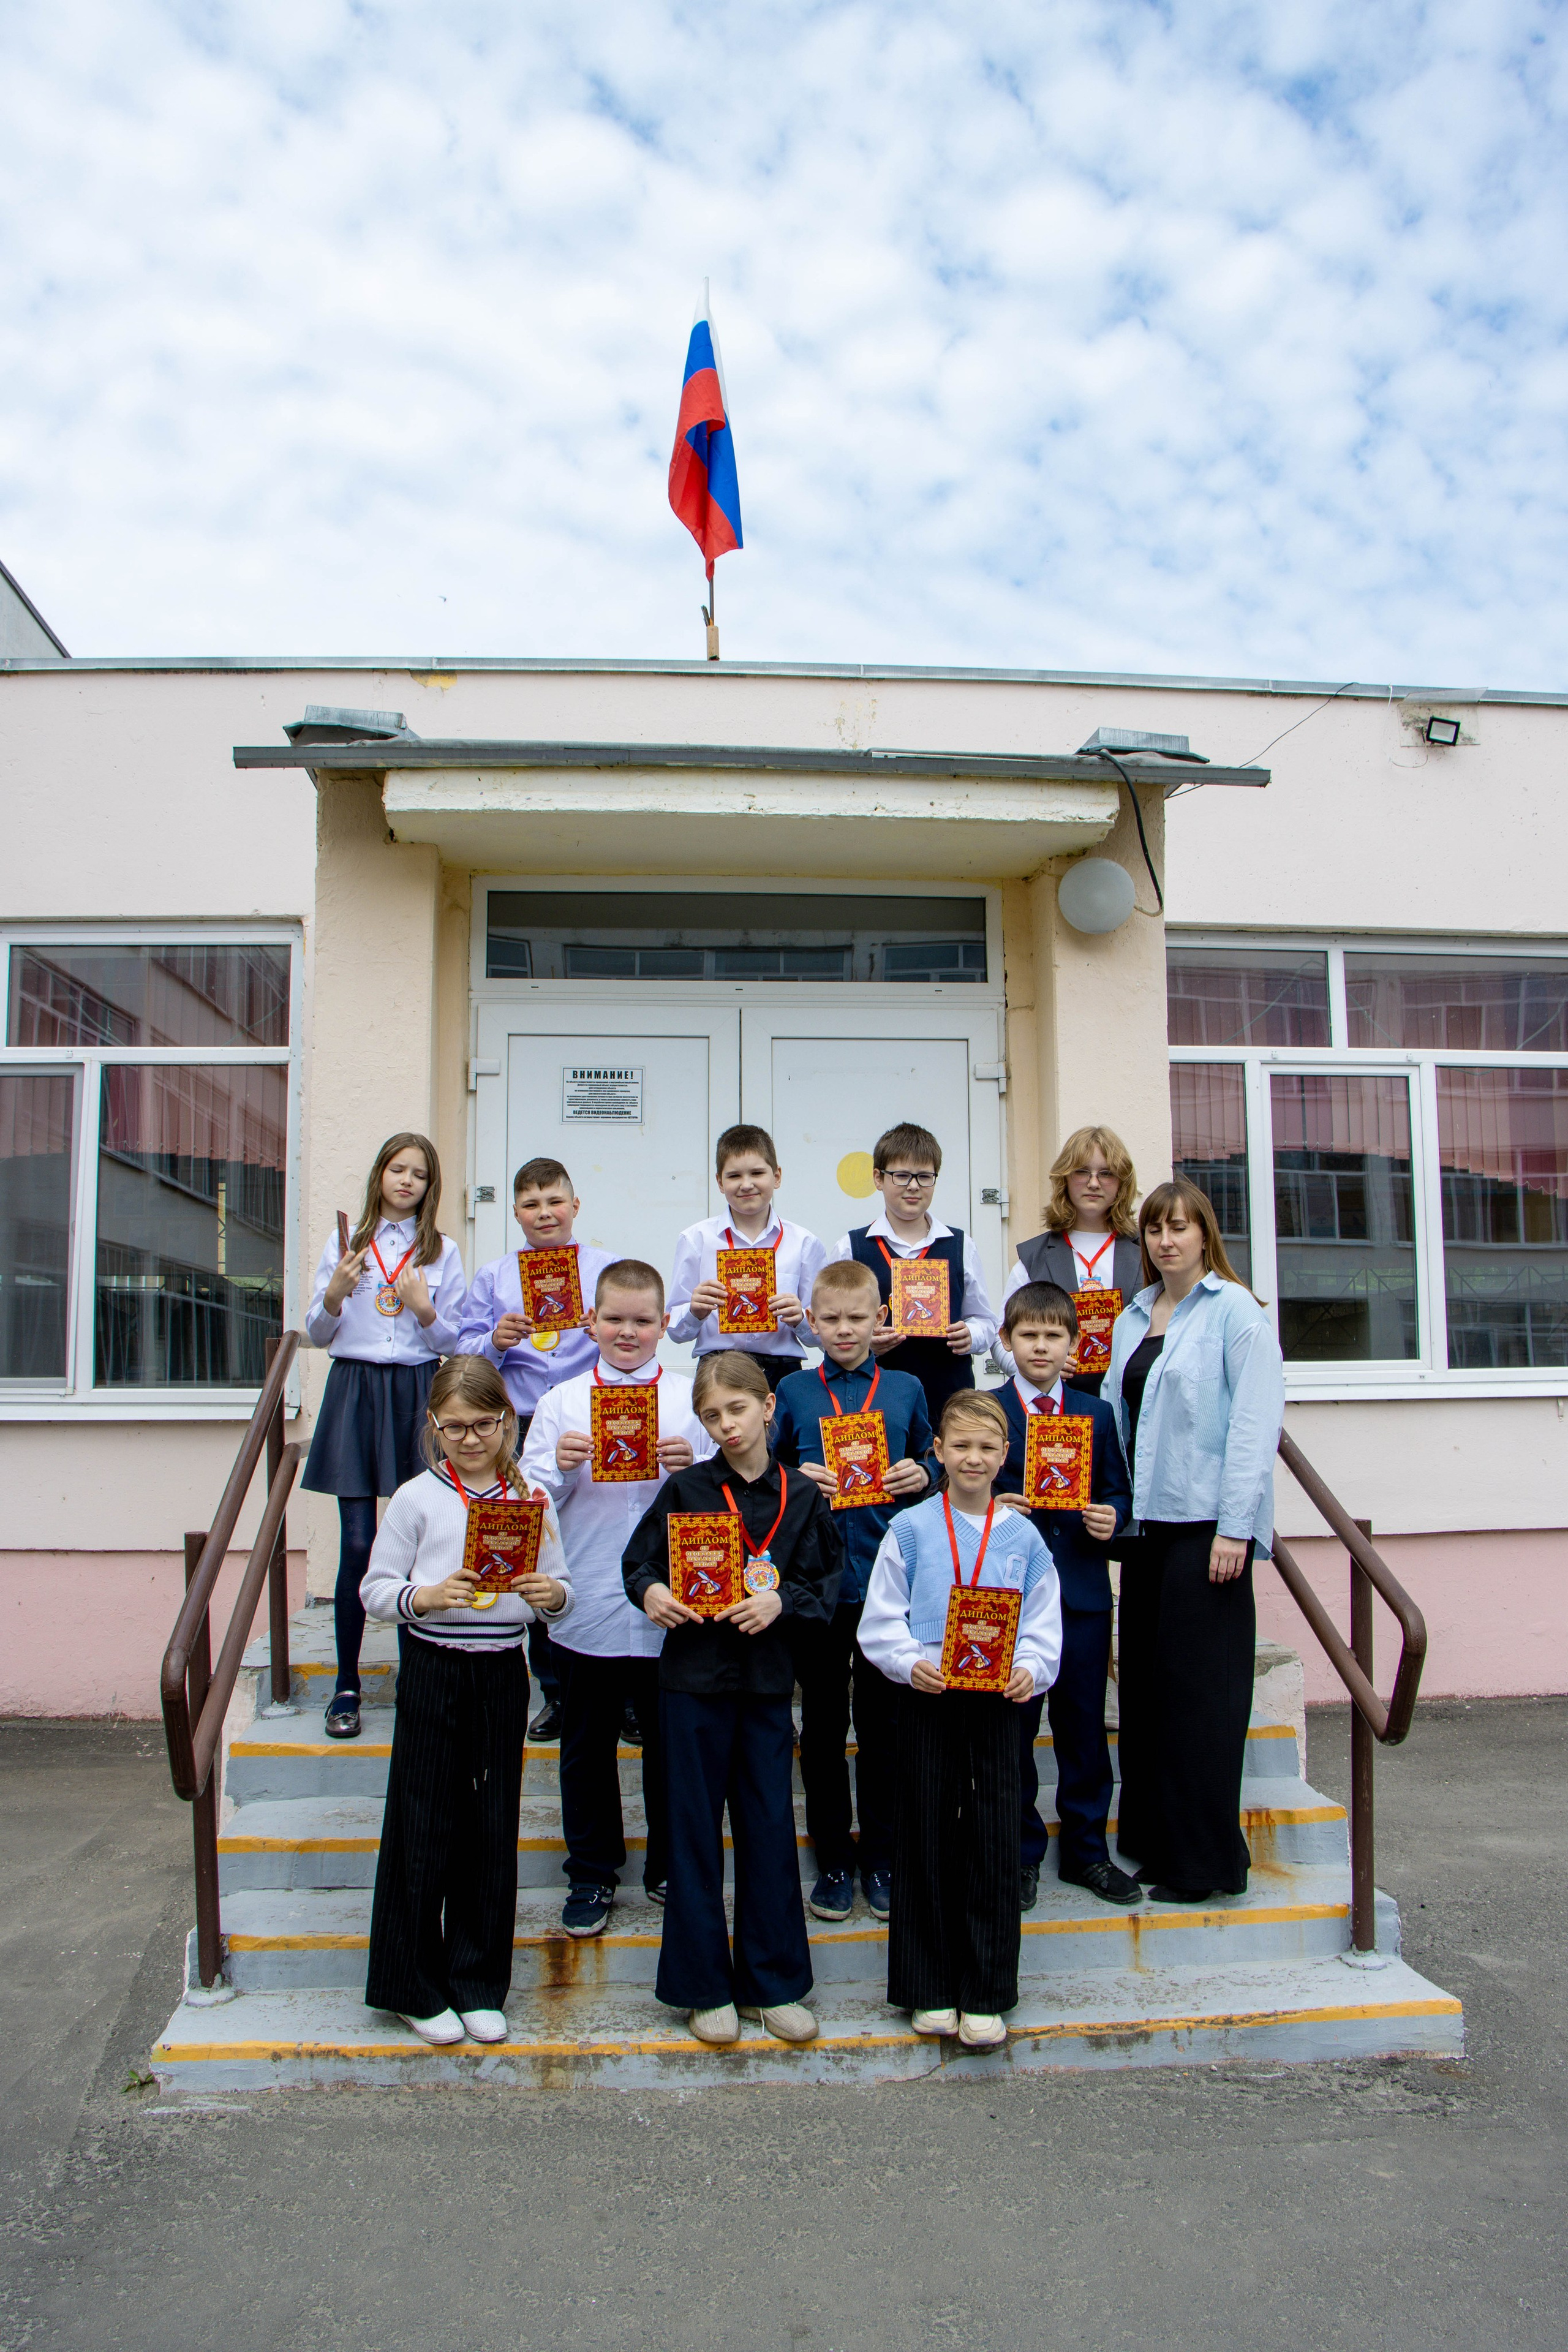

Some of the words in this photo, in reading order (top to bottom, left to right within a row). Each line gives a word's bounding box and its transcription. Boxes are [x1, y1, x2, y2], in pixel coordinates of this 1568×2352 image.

[573, 1071, 633, 1079] ВНИМАНИЕ!
[530, 1265, 568, 1276] ДИПЛОМ
[1076, 1307, 1113, 1317] ДИПЛОМ
[602, 1406, 646, 1415] ДИПЛОМ
[834, 1431, 875, 1444] ДИПЛОМ
[480, 1522, 528, 1531] ДИПЛОМ
[682, 1536, 728, 1546] ДИПЛОМ
[1003, 1552, 1028, 1589] G
[960, 1610, 1007, 1621] ДИПЛОМ
